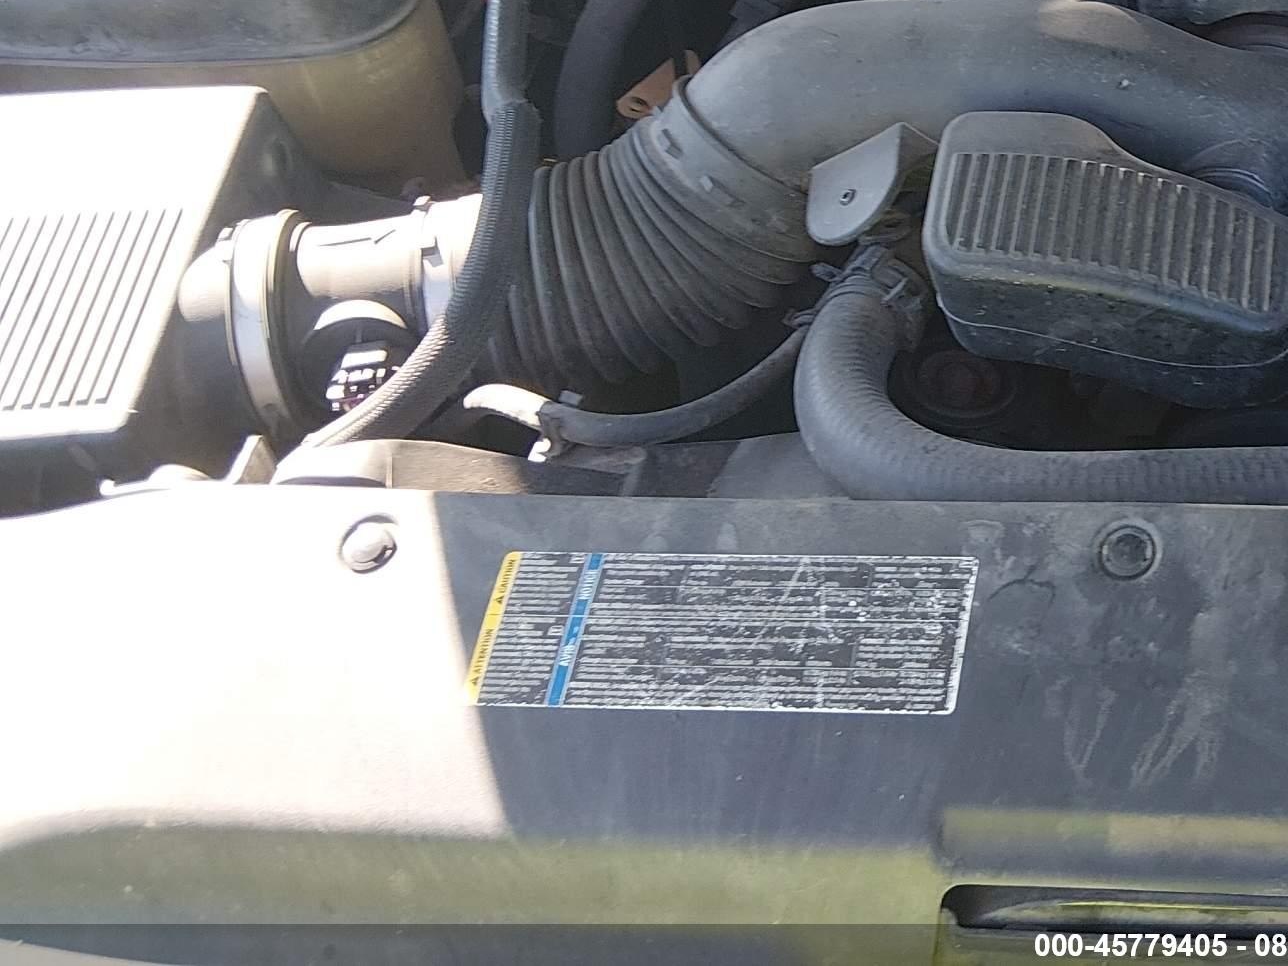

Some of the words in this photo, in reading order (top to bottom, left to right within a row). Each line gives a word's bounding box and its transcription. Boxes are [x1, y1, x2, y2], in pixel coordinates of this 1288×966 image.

[498, 559, 515, 593] CAUTION
[579, 569, 599, 601] NOTICE
[475, 628, 494, 674] ATTENTION
